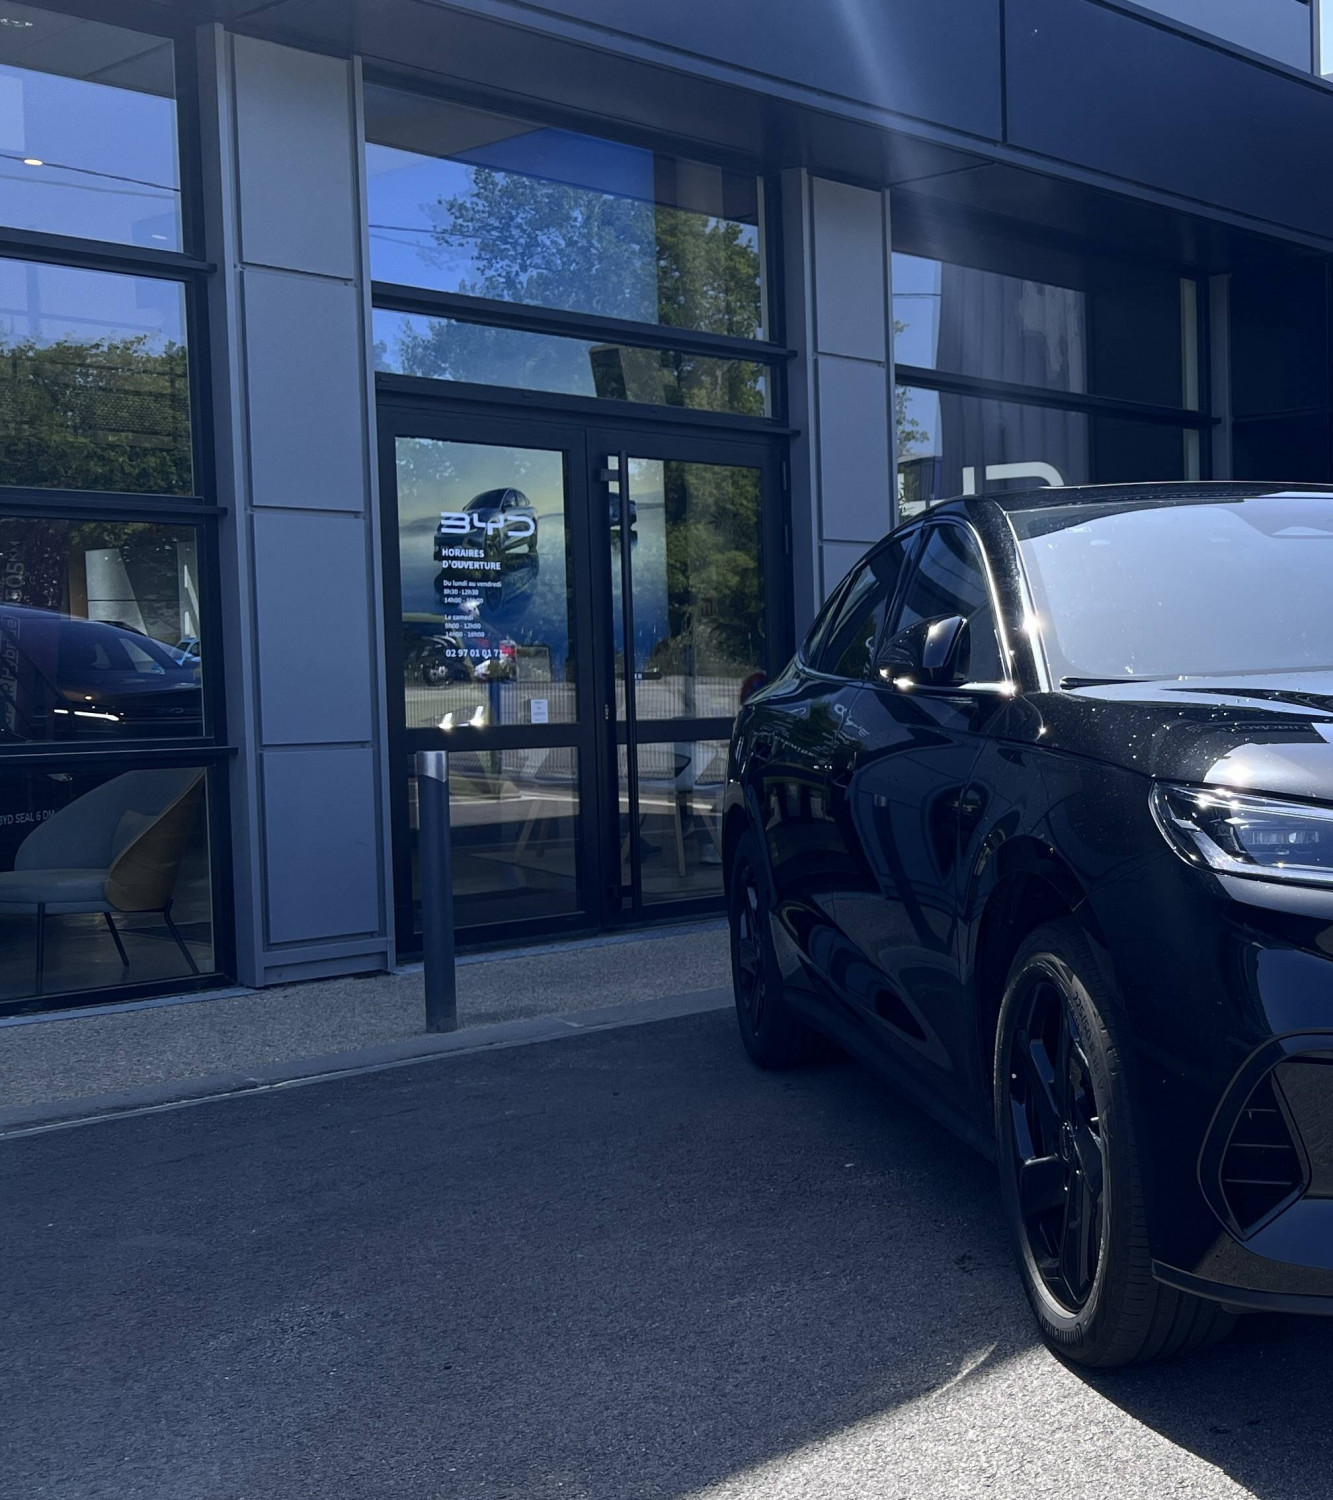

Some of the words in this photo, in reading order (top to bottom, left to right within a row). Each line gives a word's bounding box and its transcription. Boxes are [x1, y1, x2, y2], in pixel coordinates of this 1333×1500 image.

[440, 511, 536, 537] BYD
[442, 548, 485, 558] HORAIRES
[442, 560, 501, 570] D'OUVERTURE
[445, 649, 456, 658] 02
[457, 649, 468, 658] 97
[469, 649, 480, 658] 01
[481, 649, 492, 658] 01
[15, 812, 35, 824] SEAL
